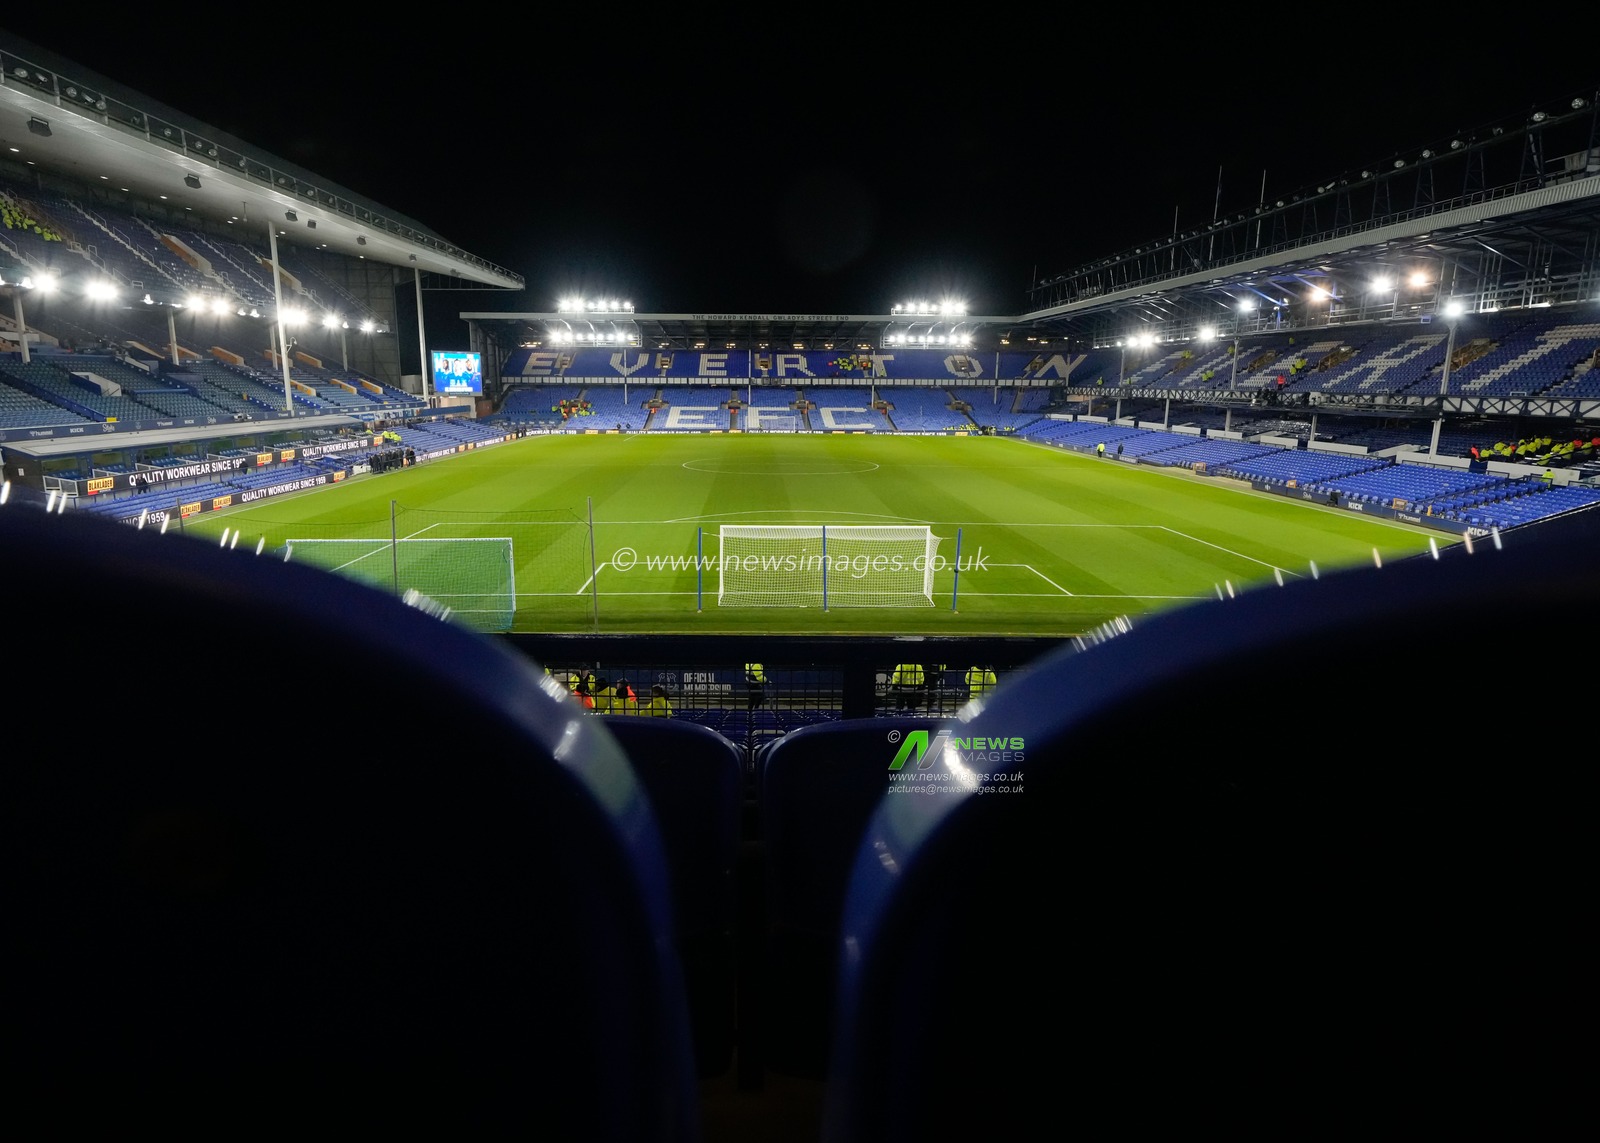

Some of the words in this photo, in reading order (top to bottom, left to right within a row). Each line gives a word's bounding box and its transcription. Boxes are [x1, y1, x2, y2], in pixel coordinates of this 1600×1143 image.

[521, 352, 1089, 378] EVERTON
[665, 406, 876, 429] EFC
[302, 447, 322, 457] QUALITY
[323, 443, 347, 454] WORKWEAR
[347, 440, 359, 449] SINCE
[129, 470, 165, 486] QALITY
[166, 464, 211, 481] WORKWEAR
[211, 460, 231, 473] SINCE
[241, 489, 267, 502] QUALITY
[267, 481, 300, 496] WORKWEAR
[300, 478, 315, 489] SINCE
[1348, 501, 1363, 511] KICK
[146, 511, 165, 524] 1959
[683, 672, 715, 683] OFFICIAL
